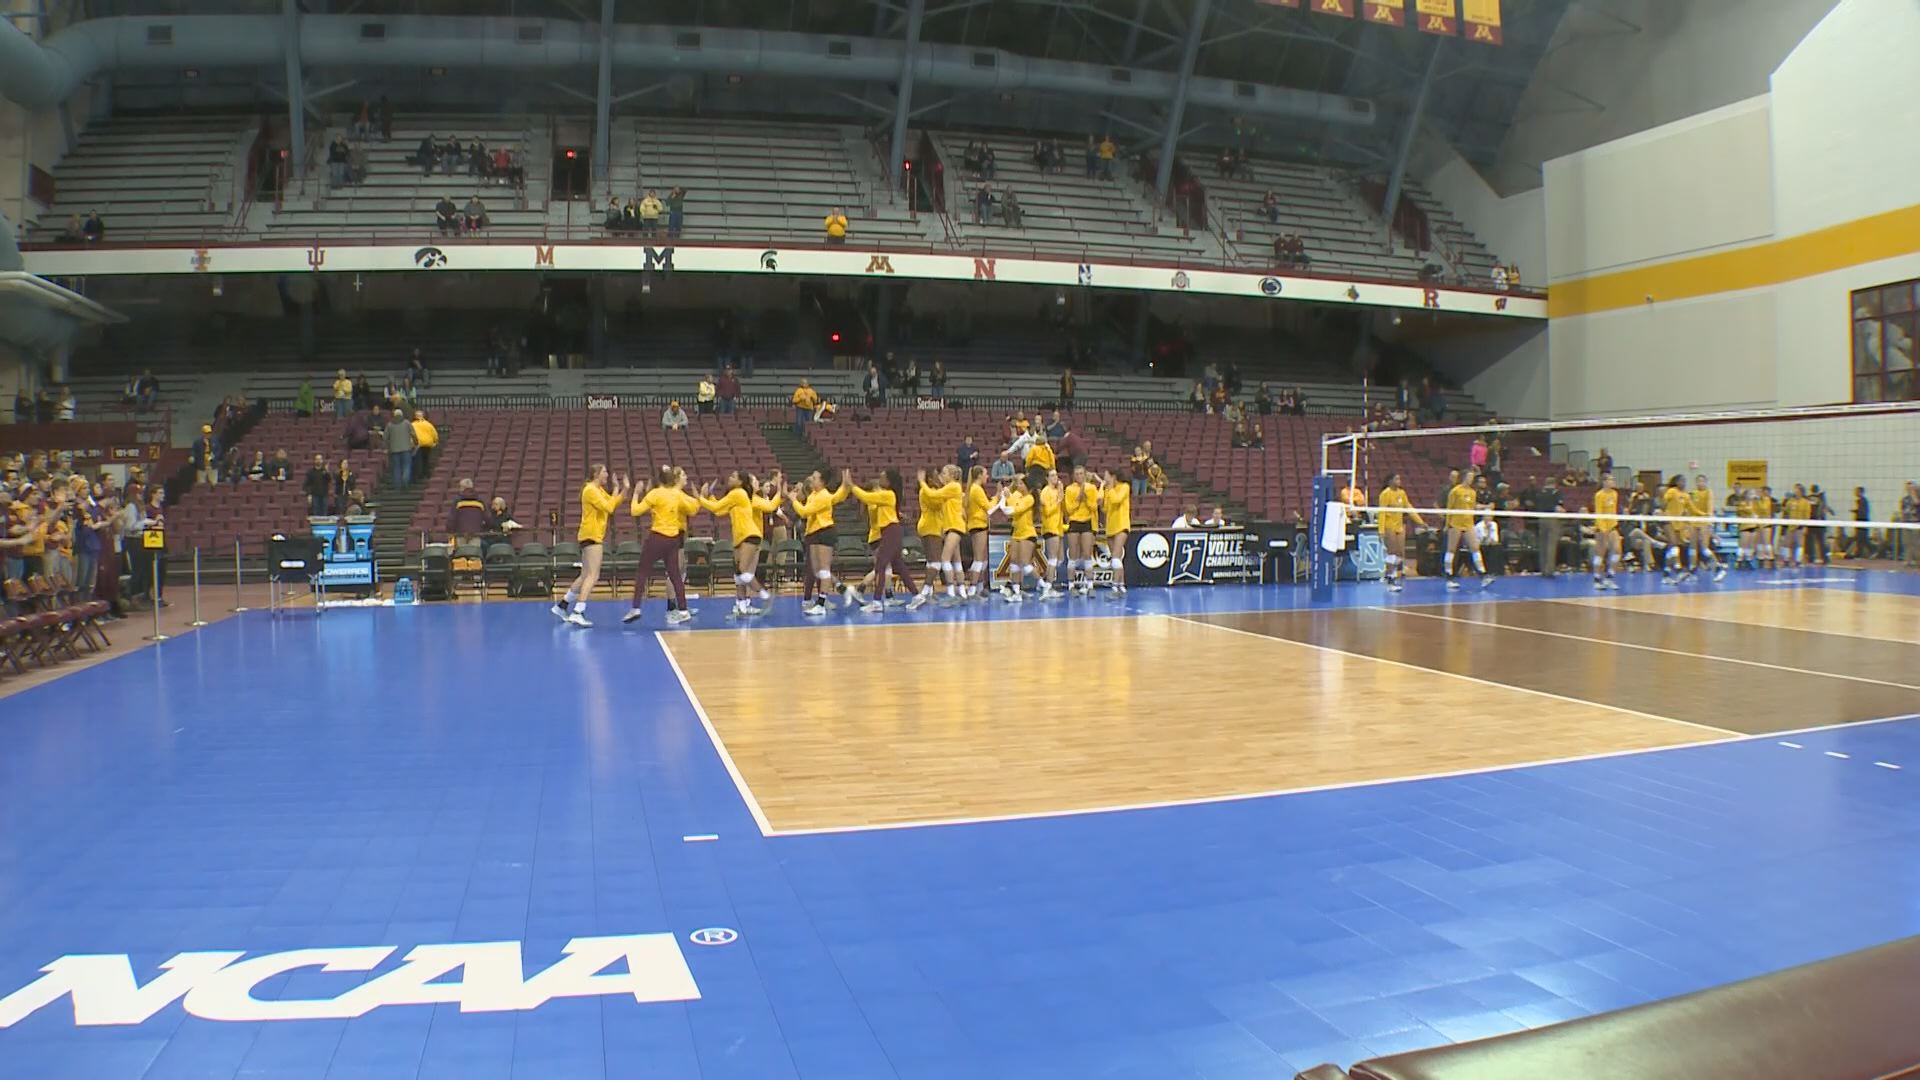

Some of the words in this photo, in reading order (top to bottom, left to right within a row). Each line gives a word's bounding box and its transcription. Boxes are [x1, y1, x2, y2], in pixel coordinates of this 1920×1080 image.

[535, 245, 555, 265] M
[643, 246, 674, 271] M
[865, 255, 895, 273] M
[974, 258, 996, 280] N
[1423, 287, 1439, 308] R
[587, 395, 612, 409] Section
[917, 396, 940, 410] Section
[1141, 549, 1168, 559] NCAA
[0, 931, 703, 1027] NCAA
